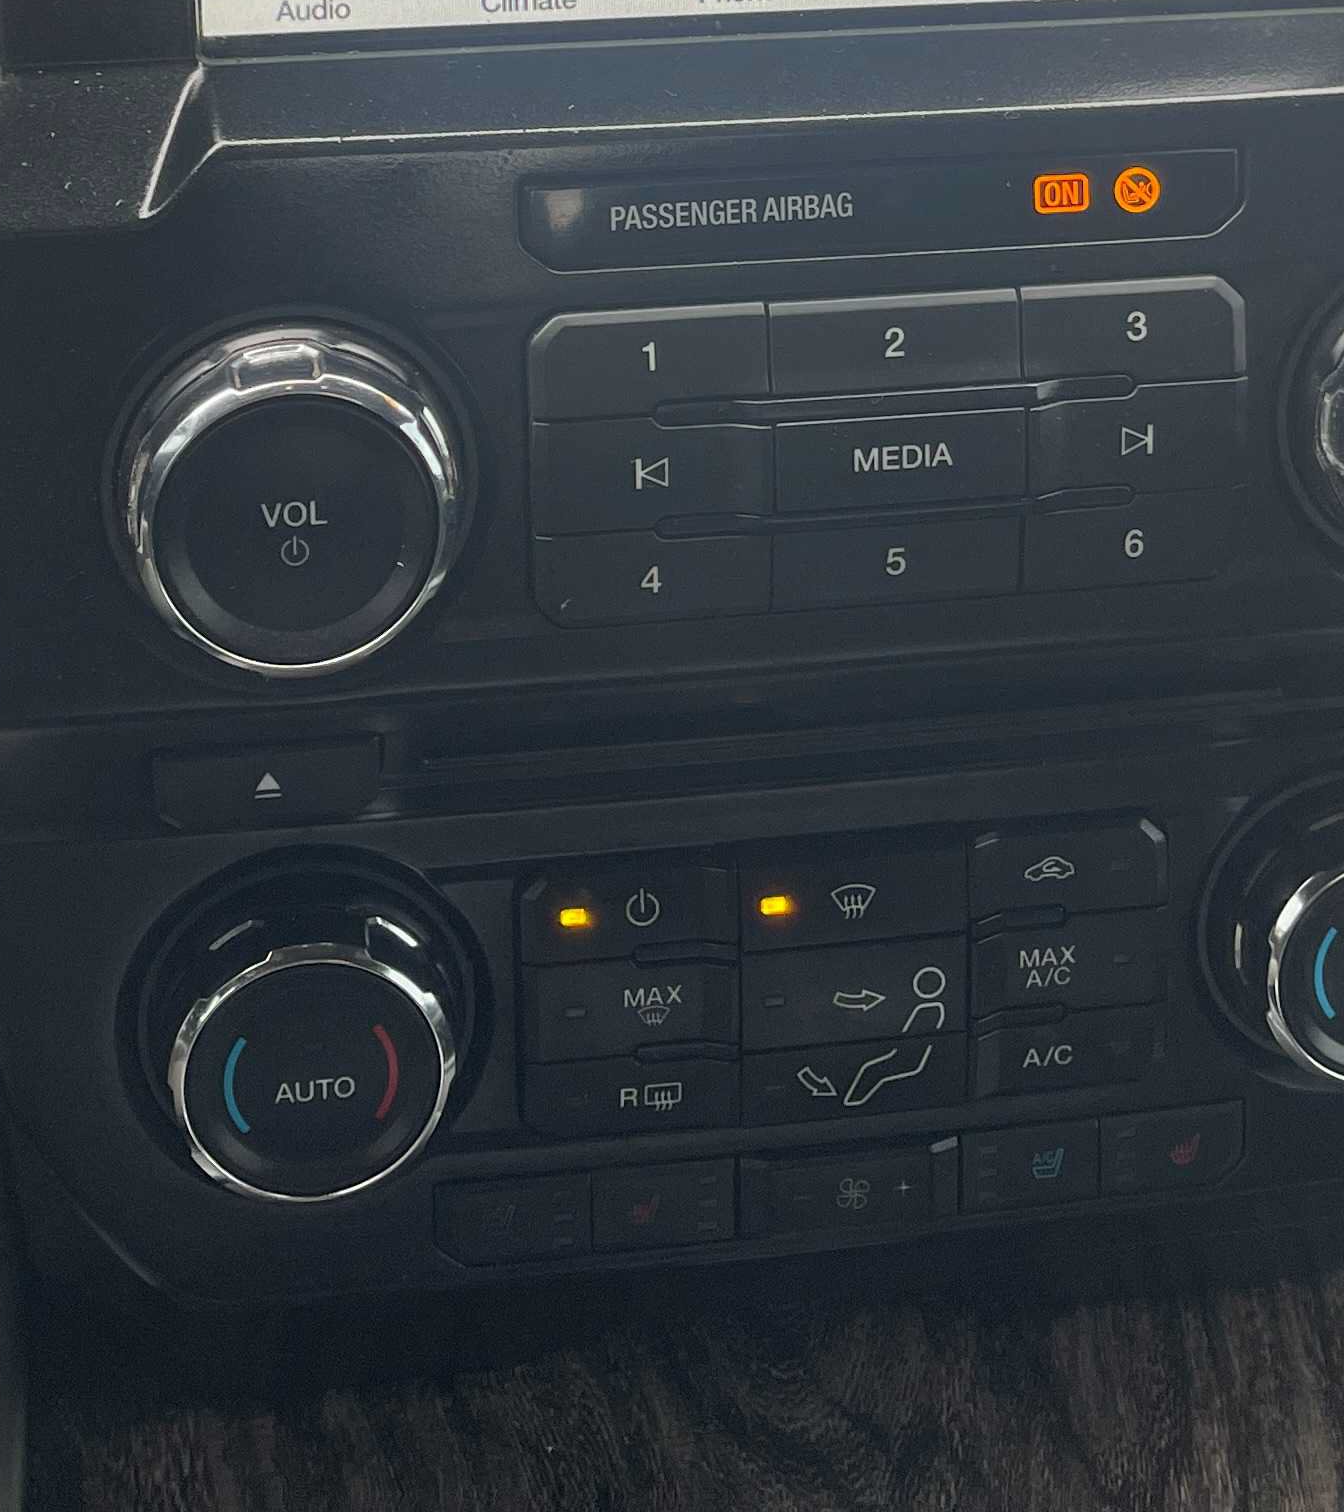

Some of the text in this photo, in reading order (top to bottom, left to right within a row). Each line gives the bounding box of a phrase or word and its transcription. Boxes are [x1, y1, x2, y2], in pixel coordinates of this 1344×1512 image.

[1043, 182, 1080, 206] ON
[610, 192, 854, 232] PASSENGER AIRBAG
[1126, 311, 1148, 341] 3
[641, 342, 657, 371] 1
[884, 328, 906, 358] 2
[853, 443, 953, 474] MEDIA
[261, 500, 328, 527] VOL
[1124, 529, 1144, 559] 6
[885, 547, 906, 577] 5
[640, 566, 661, 593] 4
[1018, 945, 1076, 970] MAX
[1025, 966, 1071, 989] A/C
[624, 985, 683, 1008] MAX
[1022, 1046, 1073, 1067] A/C
[275, 1077, 356, 1106] AUTO
[620, 1088, 639, 1108] R
